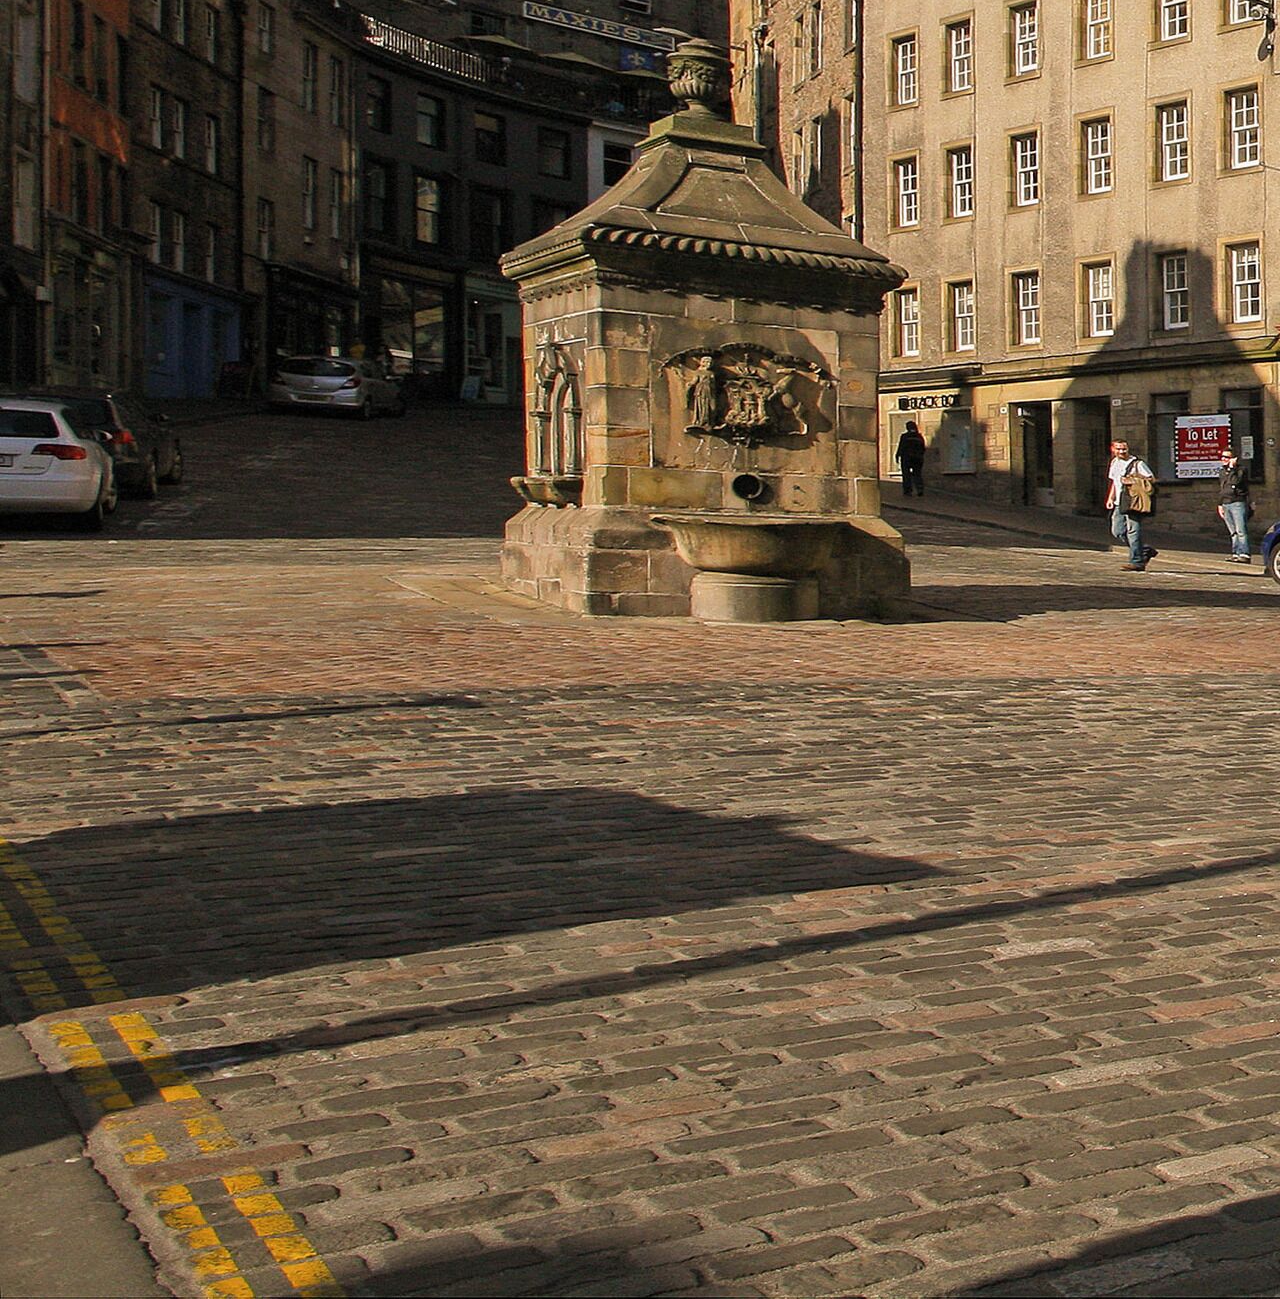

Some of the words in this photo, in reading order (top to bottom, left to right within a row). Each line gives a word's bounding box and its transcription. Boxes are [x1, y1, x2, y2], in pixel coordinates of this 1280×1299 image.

[529, 4, 642, 41] MAXIES
[1186, 428, 1199, 441] To
[1202, 428, 1218, 441] Let
